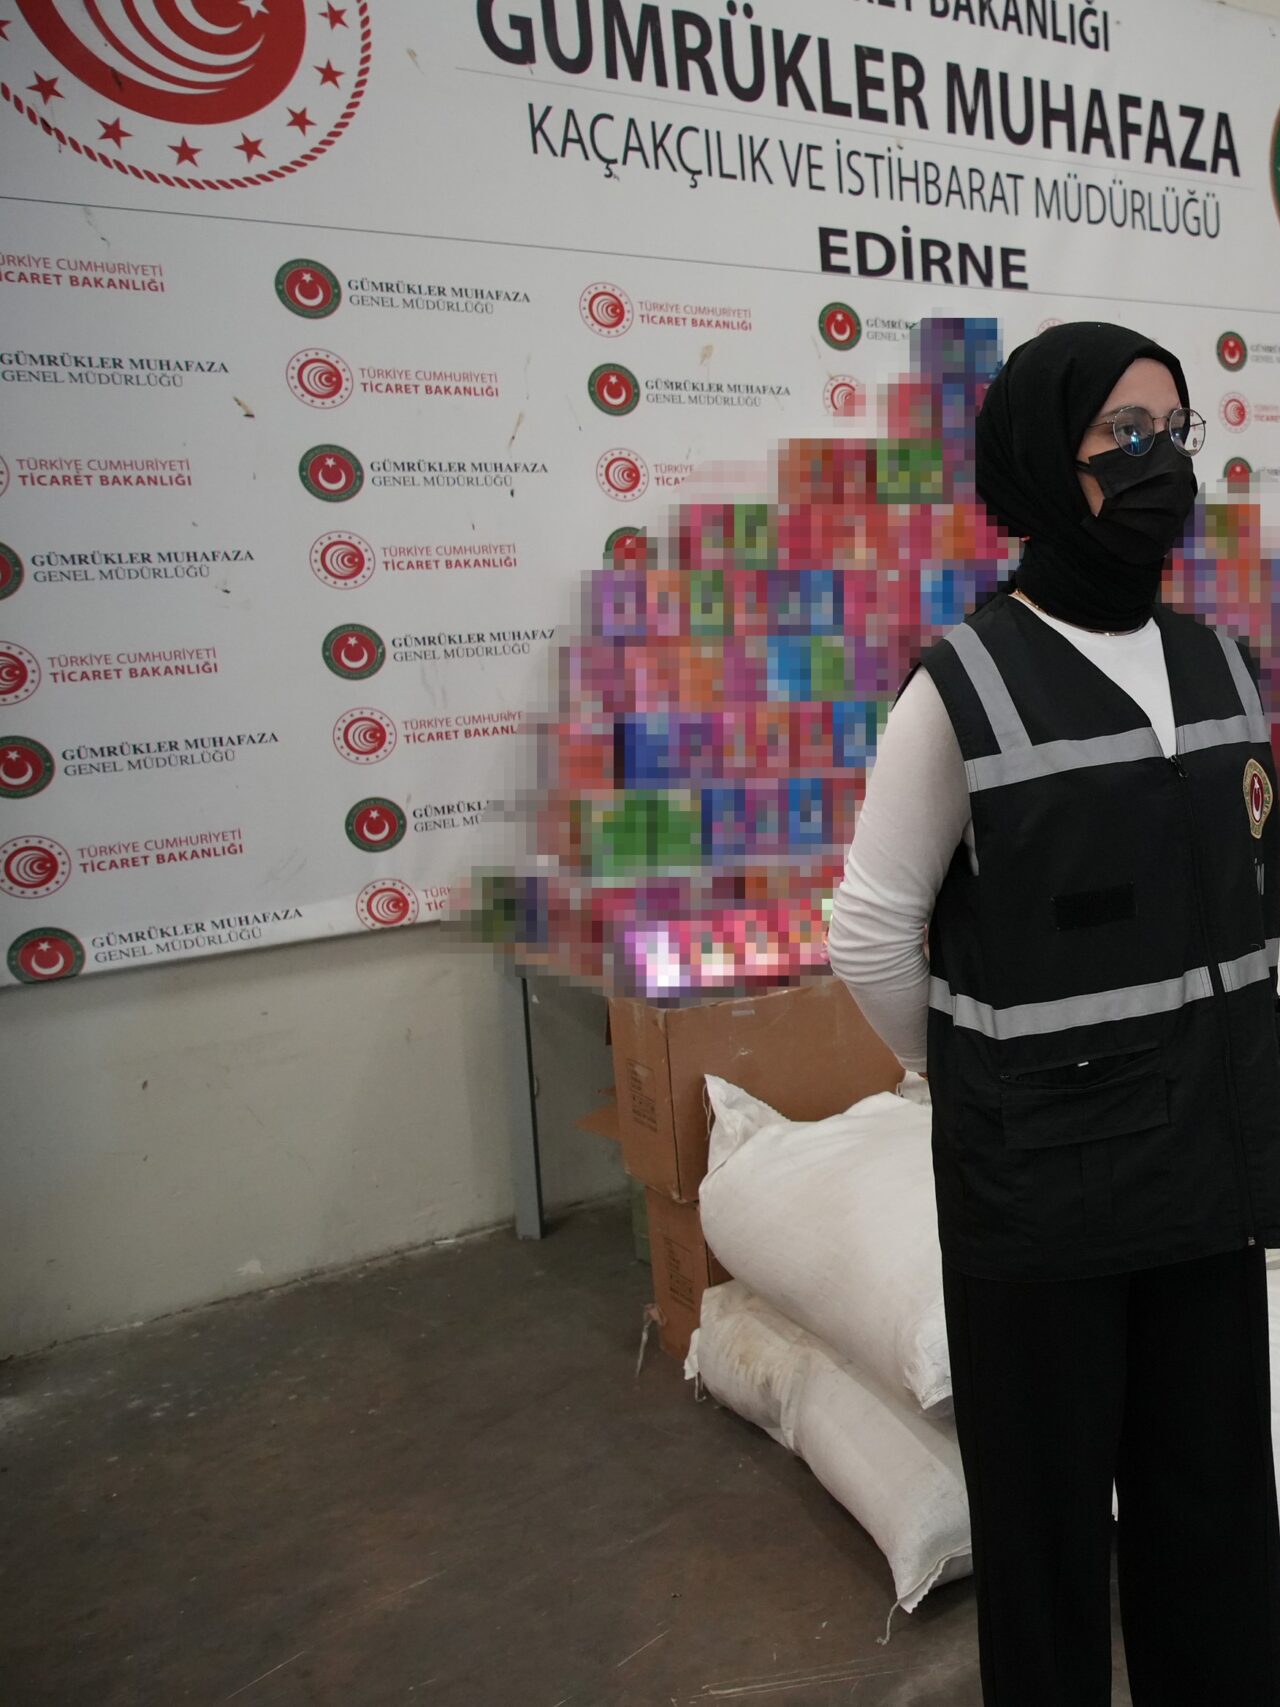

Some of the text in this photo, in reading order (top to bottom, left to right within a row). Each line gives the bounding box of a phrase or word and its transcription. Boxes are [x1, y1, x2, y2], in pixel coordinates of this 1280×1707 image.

[946, 61, 1241, 178] MUHAFAZA
[528, 102, 1221, 239] KAÇAKÇILIK VE İSTİHBARAT MÜDÜRLÜĞÜ
[56, 257, 164, 277] CUMHURİYETİ
[818, 225, 1029, 291] EDİRNE
[69, 275, 165, 293] BAKANLIĞI
[348, 278, 531, 303] GÜMRÜKLER MUHAFAZA
[349, 294, 494, 314] GENEL MÜDÜRLÜĞÜ
[637, 300, 752, 318] TÜRKİYE CUMHURİYETİ
[639, 314, 752, 331] TİCARET BAKANLIĞI
[0, 351, 229, 374] GÜMRÜKLER MUHAFAZA
[1, 369, 184, 388] GENEL MÜDÜRLÜĞÜ
[359, 366, 498, 384] TÜRKİYE CUMHURİYETİ
[360, 381, 499, 398] TİCARET BAKANLIĞI
[644, 377, 791, 396] GÜMRÜKLER MUHAFAZA
[646, 392, 685, 405] GENEL
[16, 457, 190, 472] TÜRKİYE CUMHURİYETİ
[370, 459, 549, 474] GÜMRÜKLER MUHAFAZA
[18, 472, 193, 487] TİCARET BAKANLIĞI
[371, 472, 513, 488] GENEL MÜDÜRLÜĞÜ
[31, 549, 255, 568] GÜMRÜKLER MUHAFAZA
[382, 542, 517, 558] TÜRKİYE CUMHURİYETİ
[382, 555, 518, 571] TİCARET BAKANLIĞI
[33, 565, 210, 583] GENEL MÜDÜRLÜĞÜ
[391, 628, 556, 649] GÜMRÜKLER MUHAFAZ
[48, 646, 217, 669] TÜRKİYE CUMHURİYETİ
[393, 643, 531, 662] GENEL MÜDÜRLÜĞÜ
[49, 660, 219, 684] TİCARET BAKANLIĞI
[402, 716, 452, 731] TÜRKİYE
[403, 725, 517, 744] TİCARET BAKANL
[61, 732, 279, 761] GÜMRÜKLER MUHAFAZA
[63, 750, 236, 777] GENEL MÜDÜRLÜĞÜ
[412, 799, 489, 819] GÜMRÜKL
[413, 819, 460, 833] GENEL
[77, 827, 243, 860] TÜRKİYE CUMHURİYETİ
[79, 843, 244, 874] TİCARET BAKANLIĞI
[91, 907, 304, 949] GÜMRÜKLER MUHAFAZA
[94, 927, 263, 965] GENEL MÜDÜRLÜĞÜ
